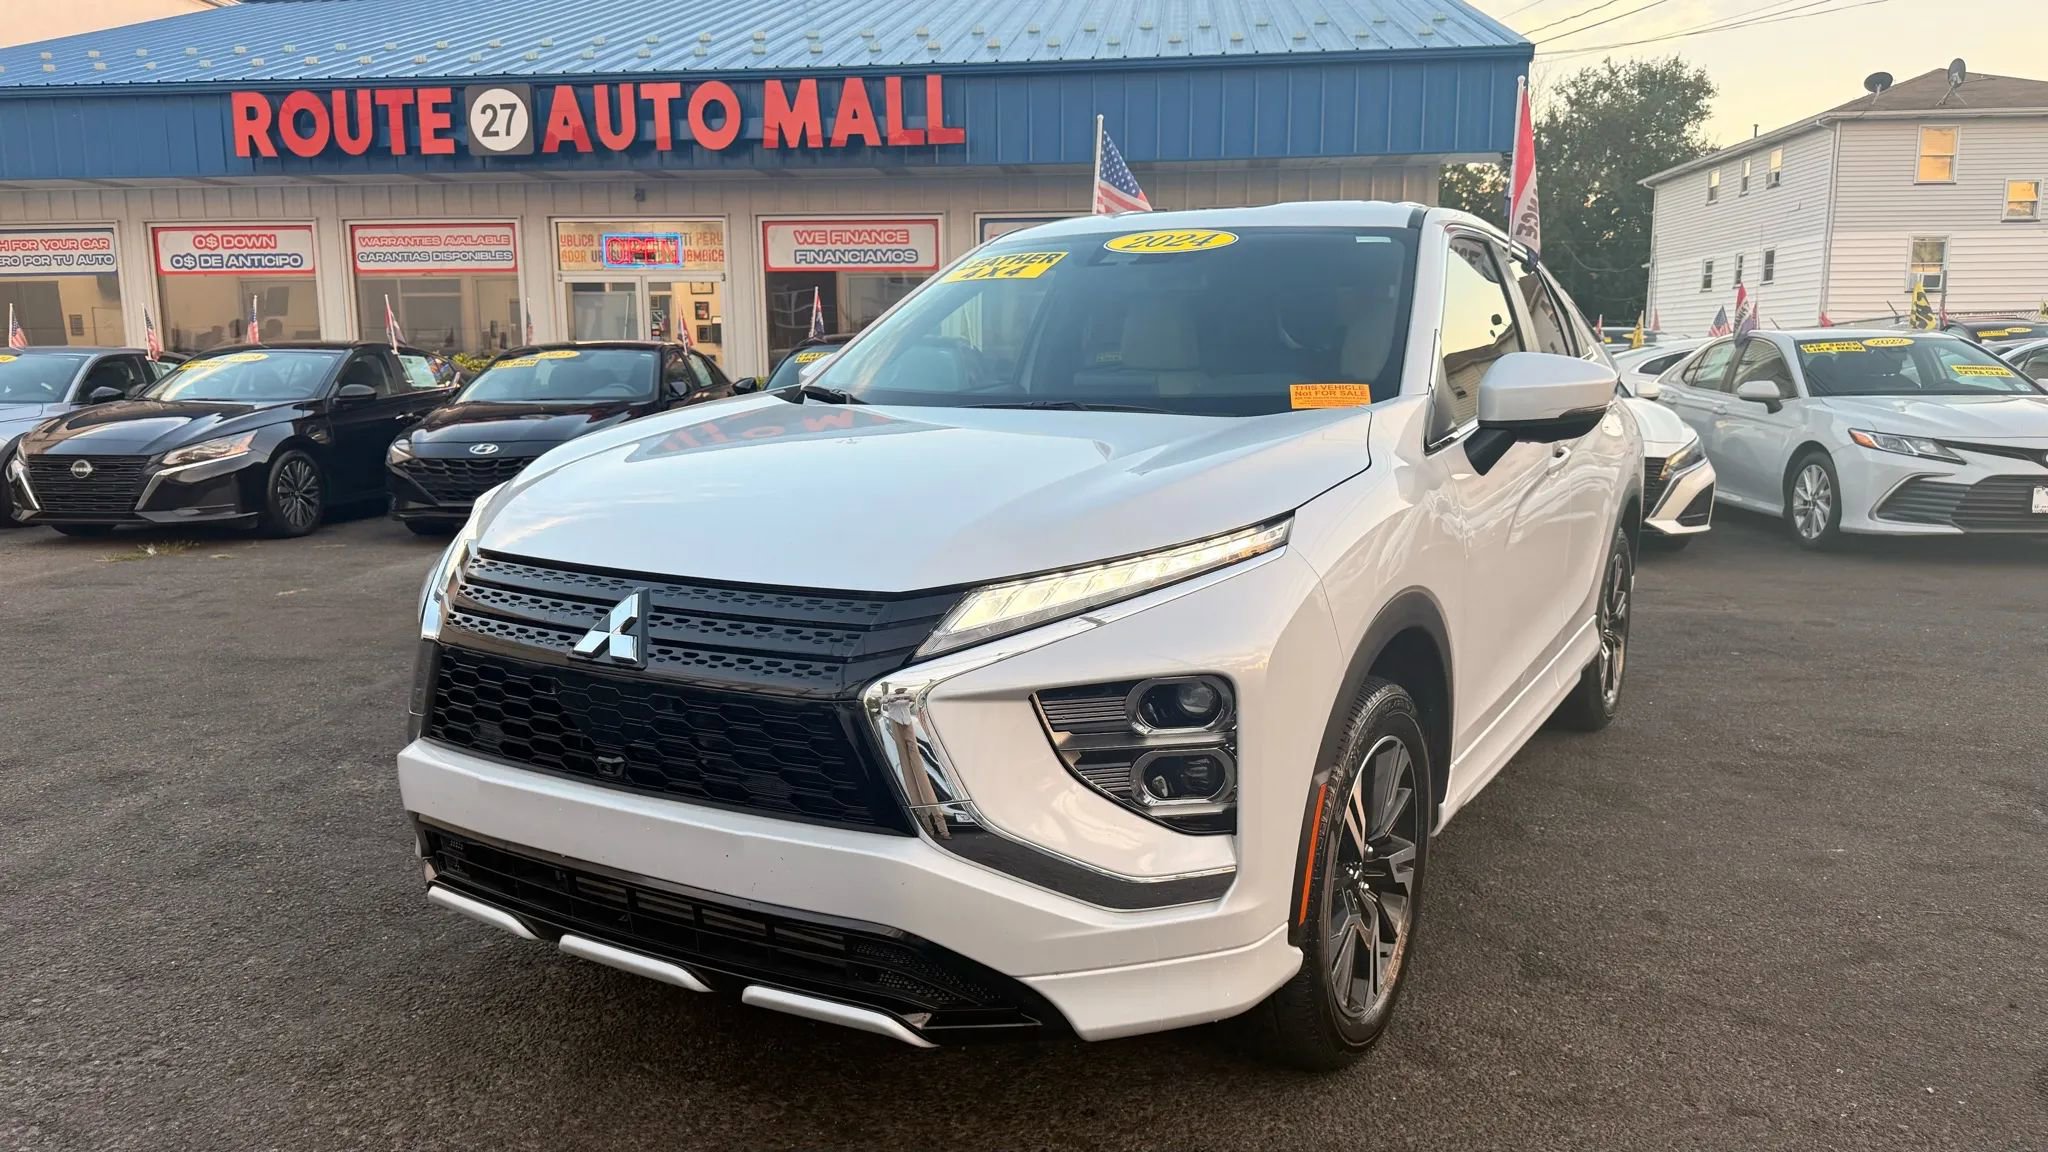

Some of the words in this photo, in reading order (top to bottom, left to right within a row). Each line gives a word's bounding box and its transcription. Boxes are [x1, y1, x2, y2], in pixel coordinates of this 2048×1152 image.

[231, 87, 456, 157] ROUTE
[480, 103, 517, 137] 27
[542, 80, 741, 152] AUTO
[763, 75, 965, 149] MALL
[11, 239, 38, 251] FOR
[41, 239, 79, 251] YOUR
[80, 238, 109, 250] CAR
[222, 234, 277, 249] DOWN
[358, 235, 441, 247] WARRANTIES
[444, 234, 510, 246] AVAILABLE
[696, 231, 724, 246] PERU
[794, 230, 827, 245] WE
[830, 229, 909, 245] FINANCE
[1122, 233, 1219, 248] 2024
[358, 251, 430, 263] GARANTIAS
[431, 250, 513, 262] DISPONIBLES
[606, 238, 678, 264] OPEN
[794, 249, 918, 264] FINANCIAMOS
[23, 254, 52, 266] POR
[53, 254, 74, 265] TU
[76, 253, 114, 265] AUTO
[199, 254, 224, 268] DE
[226, 253, 303, 268] ANTICIPO
[959, 253, 1062, 270] LEATHER
